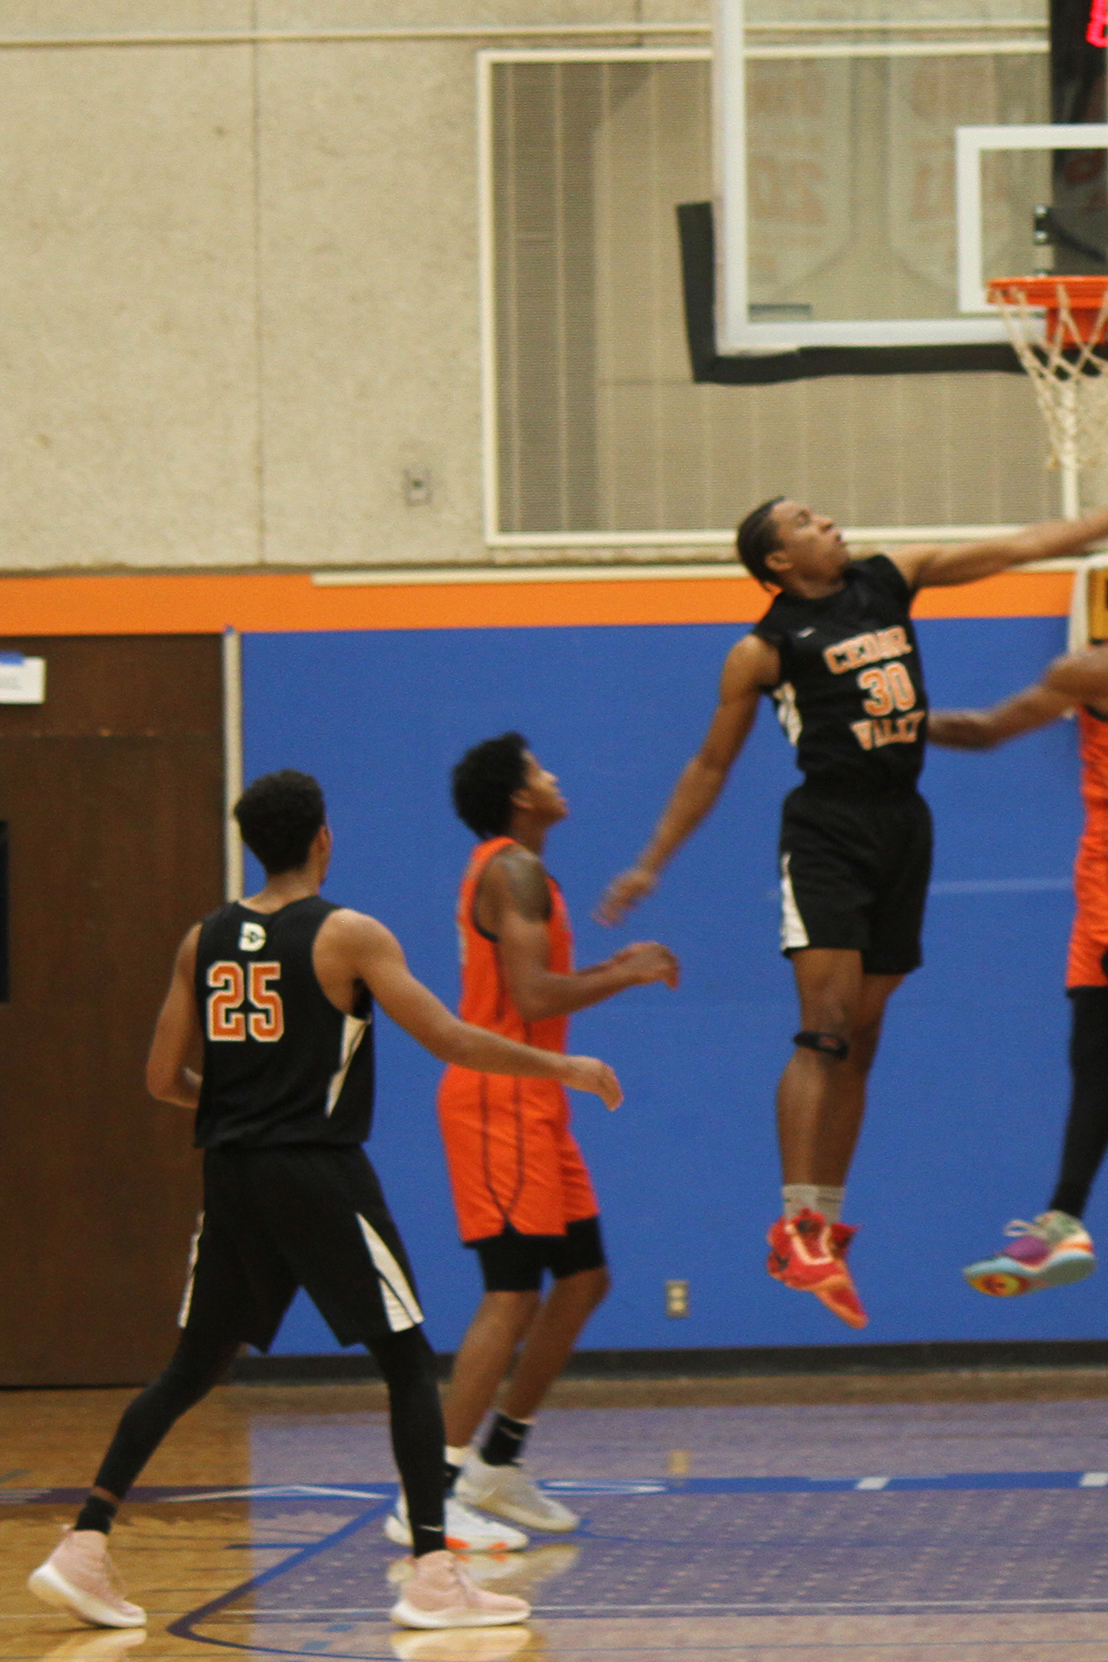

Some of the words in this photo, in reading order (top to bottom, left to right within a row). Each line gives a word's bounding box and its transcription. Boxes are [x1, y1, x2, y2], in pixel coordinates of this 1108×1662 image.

[822, 625, 913, 675] CEDAR
[856, 661, 917, 716] 30
[206, 960, 285, 1042] 25
